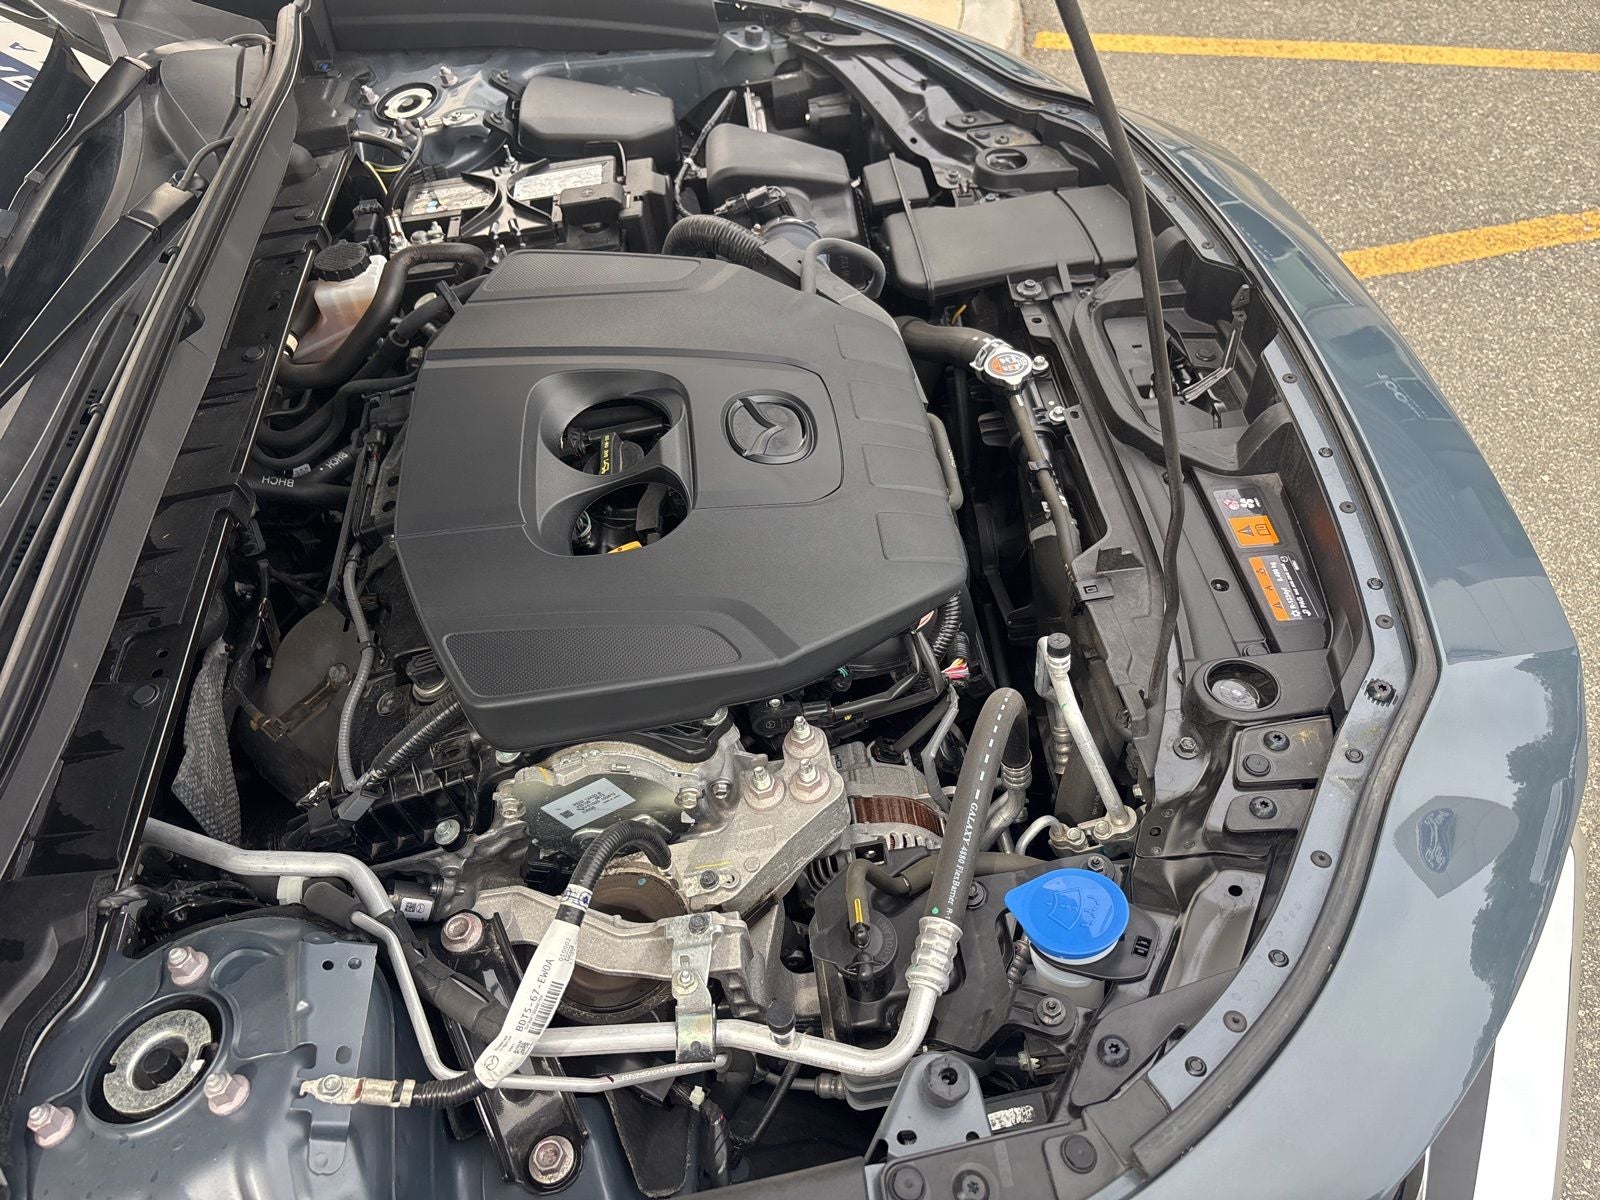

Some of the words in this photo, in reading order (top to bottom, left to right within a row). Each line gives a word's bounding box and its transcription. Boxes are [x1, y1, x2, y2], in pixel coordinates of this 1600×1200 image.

[325, 451, 348, 469] BHCH
[261, 475, 295, 488] BHCH
[963, 802, 978, 846] GALAXY
[958, 846, 968, 864] 4880
[947, 864, 964, 905] FlexBarrier
